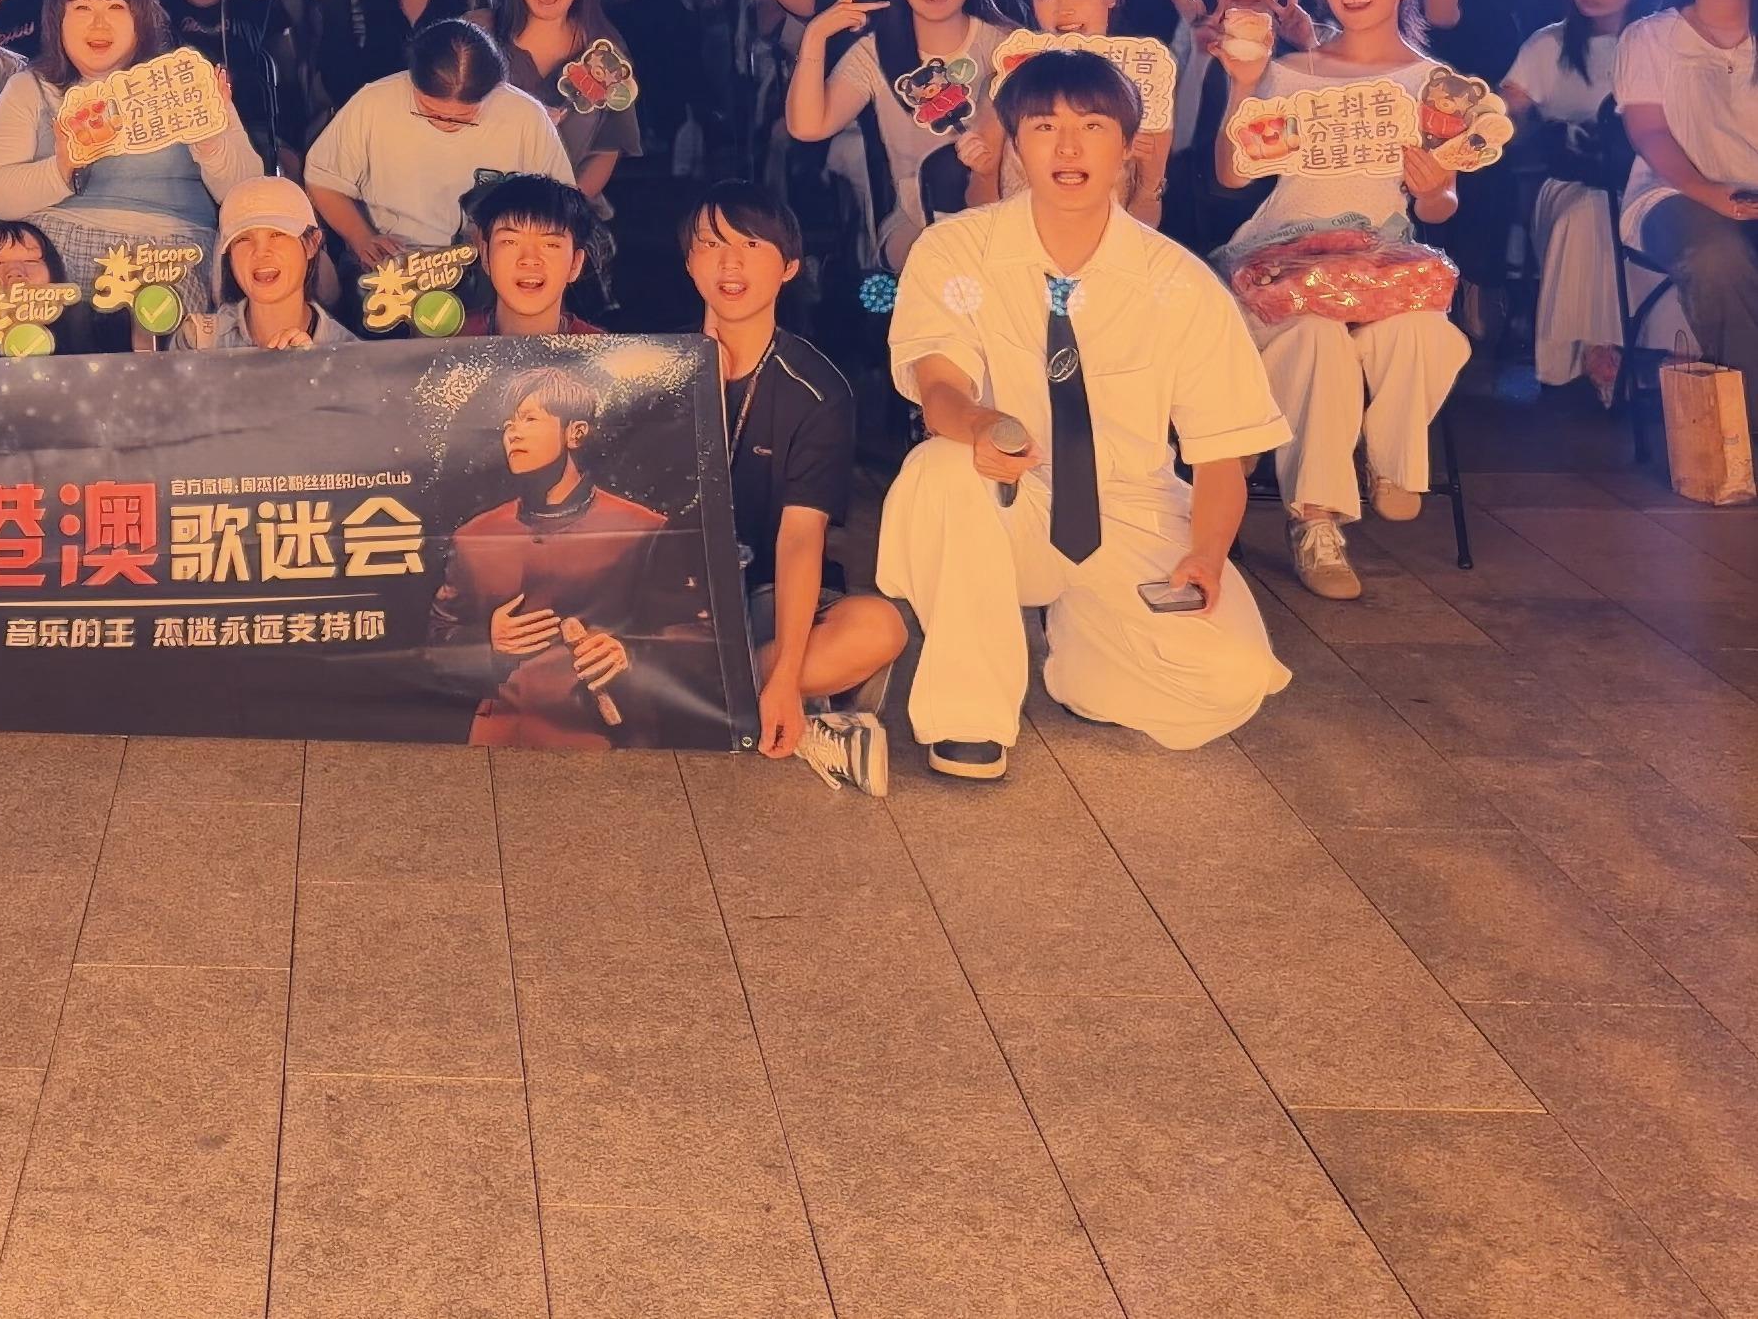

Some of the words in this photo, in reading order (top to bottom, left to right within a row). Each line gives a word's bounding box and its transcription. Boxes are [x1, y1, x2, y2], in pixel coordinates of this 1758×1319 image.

[122, 59, 195, 101] 上抖音
[125, 87, 203, 120] 分享我的
[1303, 89, 1396, 123] 上抖音
[125, 106, 209, 146] 追星生活
[1307, 120, 1400, 145] 分享我的
[1302, 142, 1402, 170] 追星生活
[137, 243, 199, 265] Encore
[407, 246, 473, 276] Encore
[143, 264, 181, 283] Club
[417, 265, 458, 291] Club
[10, 282, 76, 303] Encore
[15, 301, 59, 322] Club
[170, 496, 425, 583] 歌迷会
[5, 617, 135, 648] 音乐的王
[152, 610, 386, 647] 杰迷永远支持你
